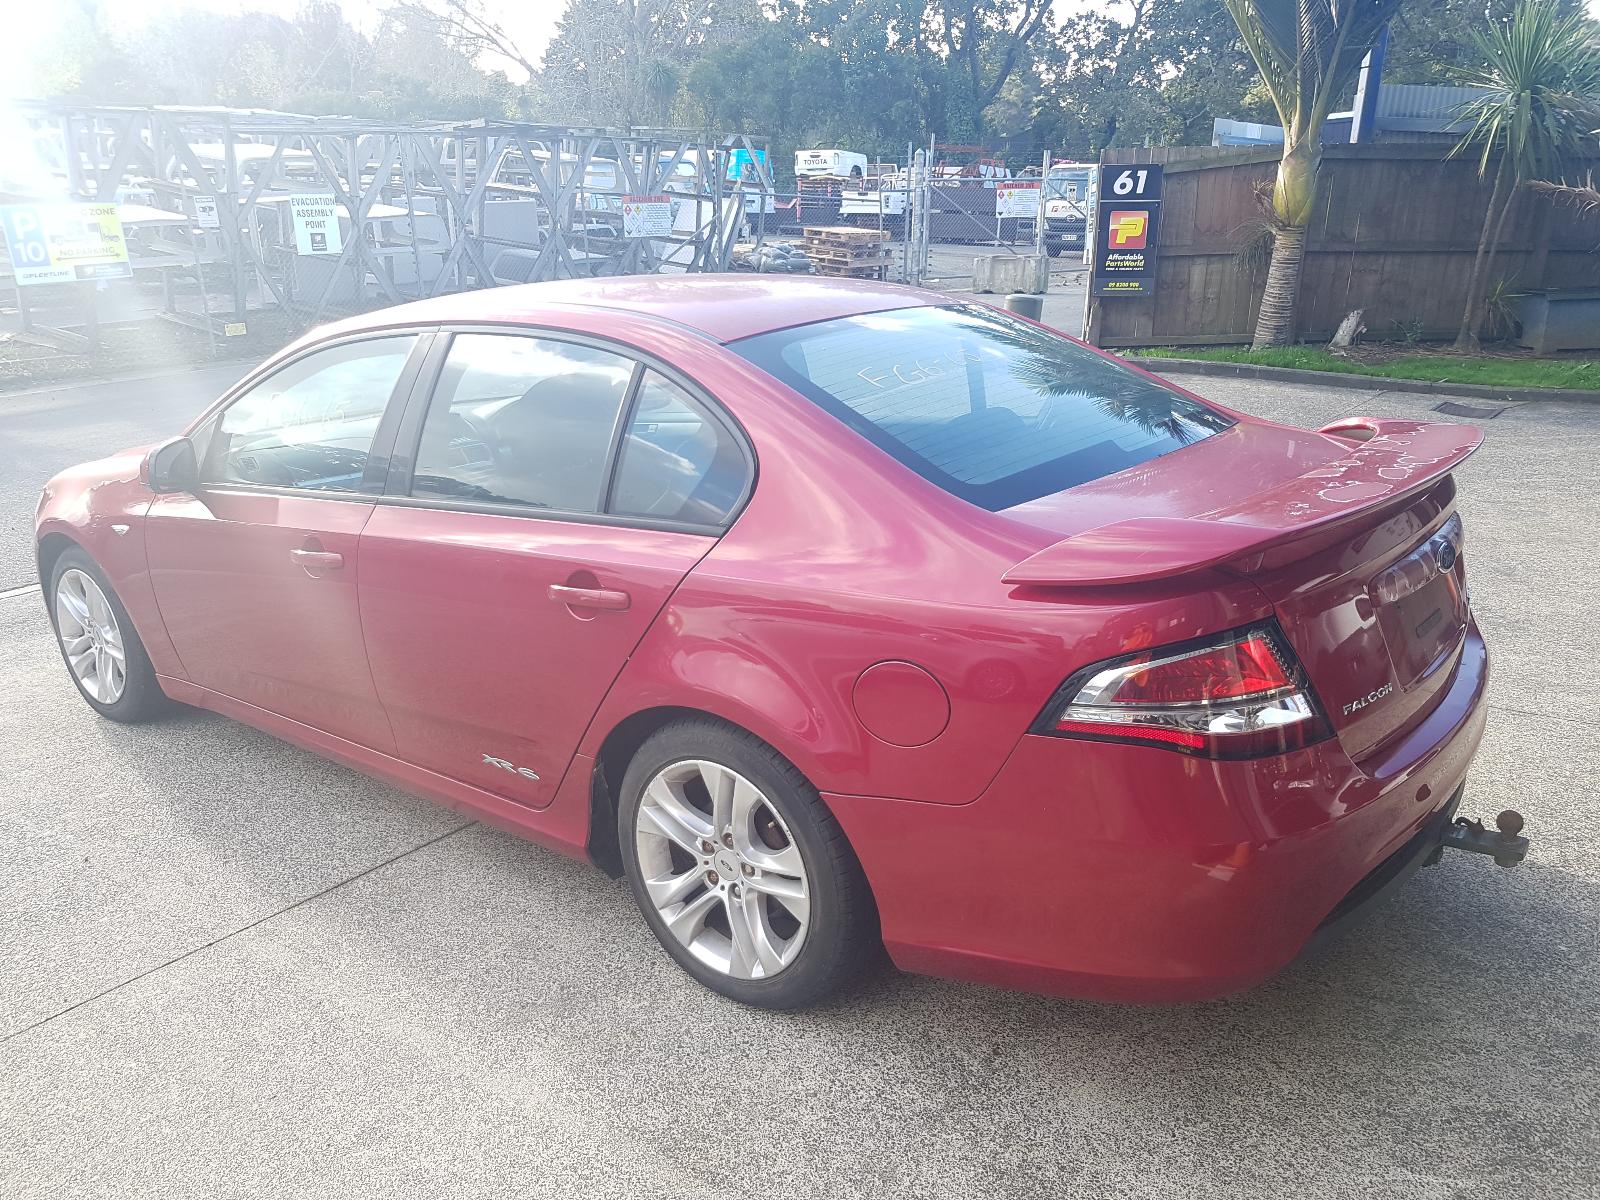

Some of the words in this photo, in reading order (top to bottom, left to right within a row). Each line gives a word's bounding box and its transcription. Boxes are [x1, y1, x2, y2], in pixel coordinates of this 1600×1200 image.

[1113, 170, 1148, 195] 61
[291, 197, 336, 206] EVACUATION
[89, 208, 117, 216] ZONE
[297, 209, 334, 217] ASSEMBLY
[305, 220, 326, 228] POINT
[14, 241, 46, 262] 10
[1105, 259, 1145, 267] PartsWorld
[1342, 682, 1393, 715] FALCON
[482, 753, 540, 780] XR6
